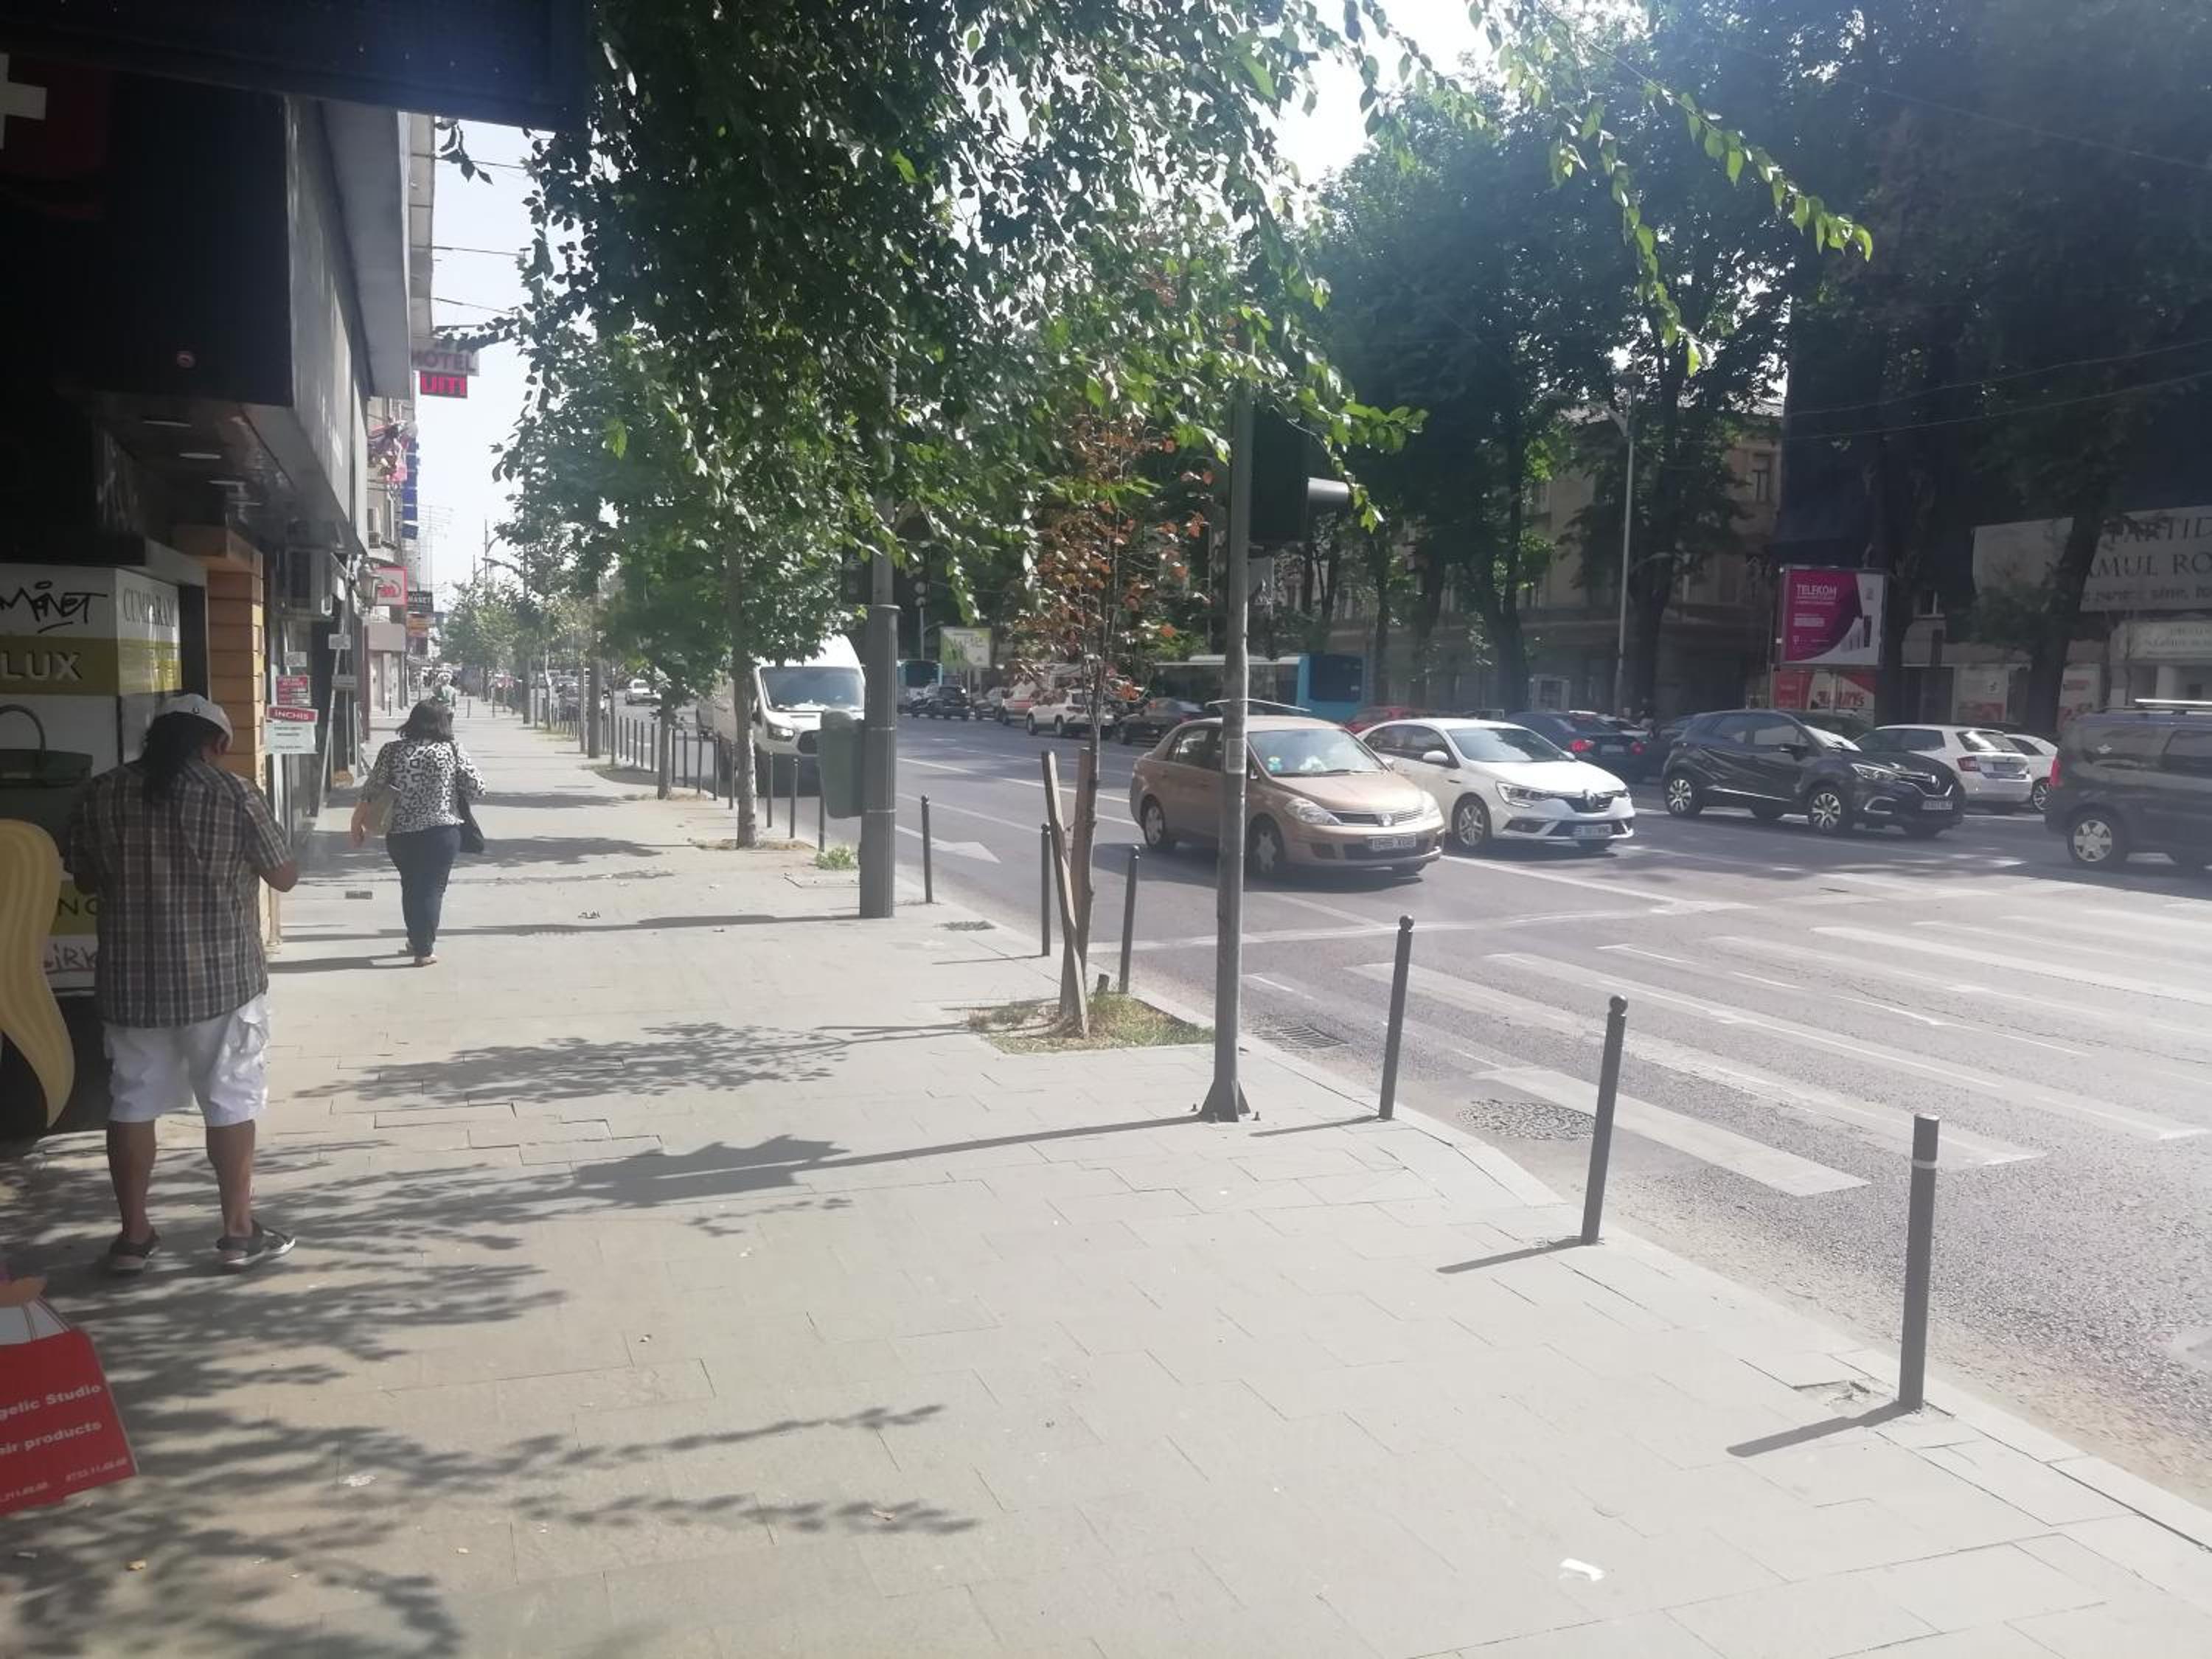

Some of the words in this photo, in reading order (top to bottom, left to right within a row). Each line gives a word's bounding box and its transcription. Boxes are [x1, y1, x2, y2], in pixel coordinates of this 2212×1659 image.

[1796, 583, 1837, 598] TELEKOM
[0, 650, 83, 681] LUX
[45, 1384, 102, 1405] Studio
[24, 1421, 102, 1452] products
